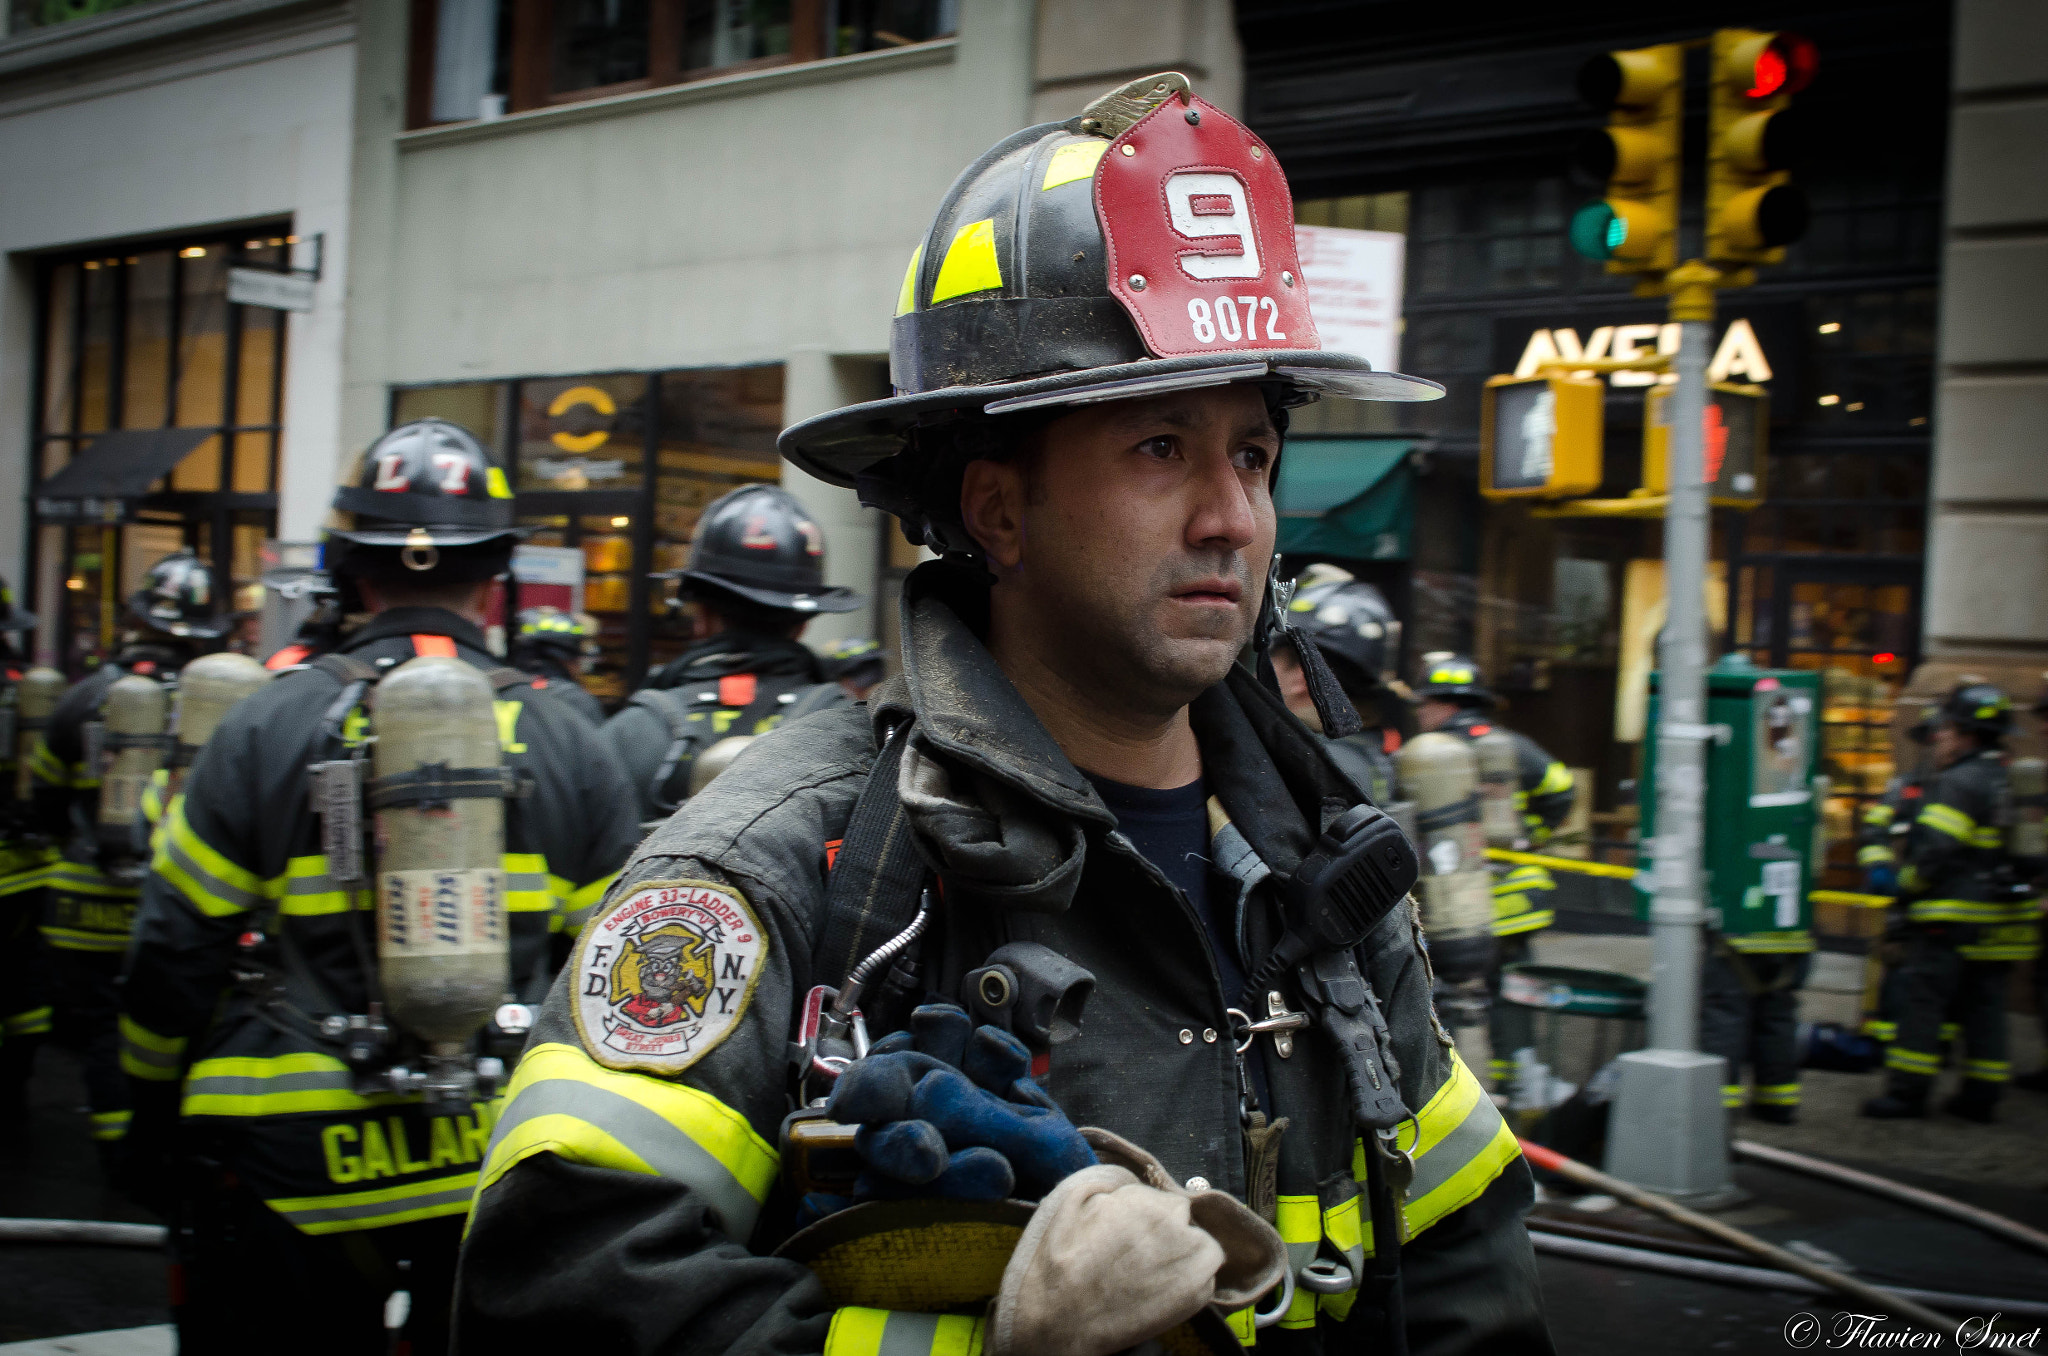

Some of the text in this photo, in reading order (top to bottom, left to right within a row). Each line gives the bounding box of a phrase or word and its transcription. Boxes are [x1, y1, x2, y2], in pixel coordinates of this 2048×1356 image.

[1165, 172, 1264, 280] 9
[1187, 295, 1287, 344] 8072
[604, 894, 653, 932] ENGINE
[737, 933, 753, 943] 9
